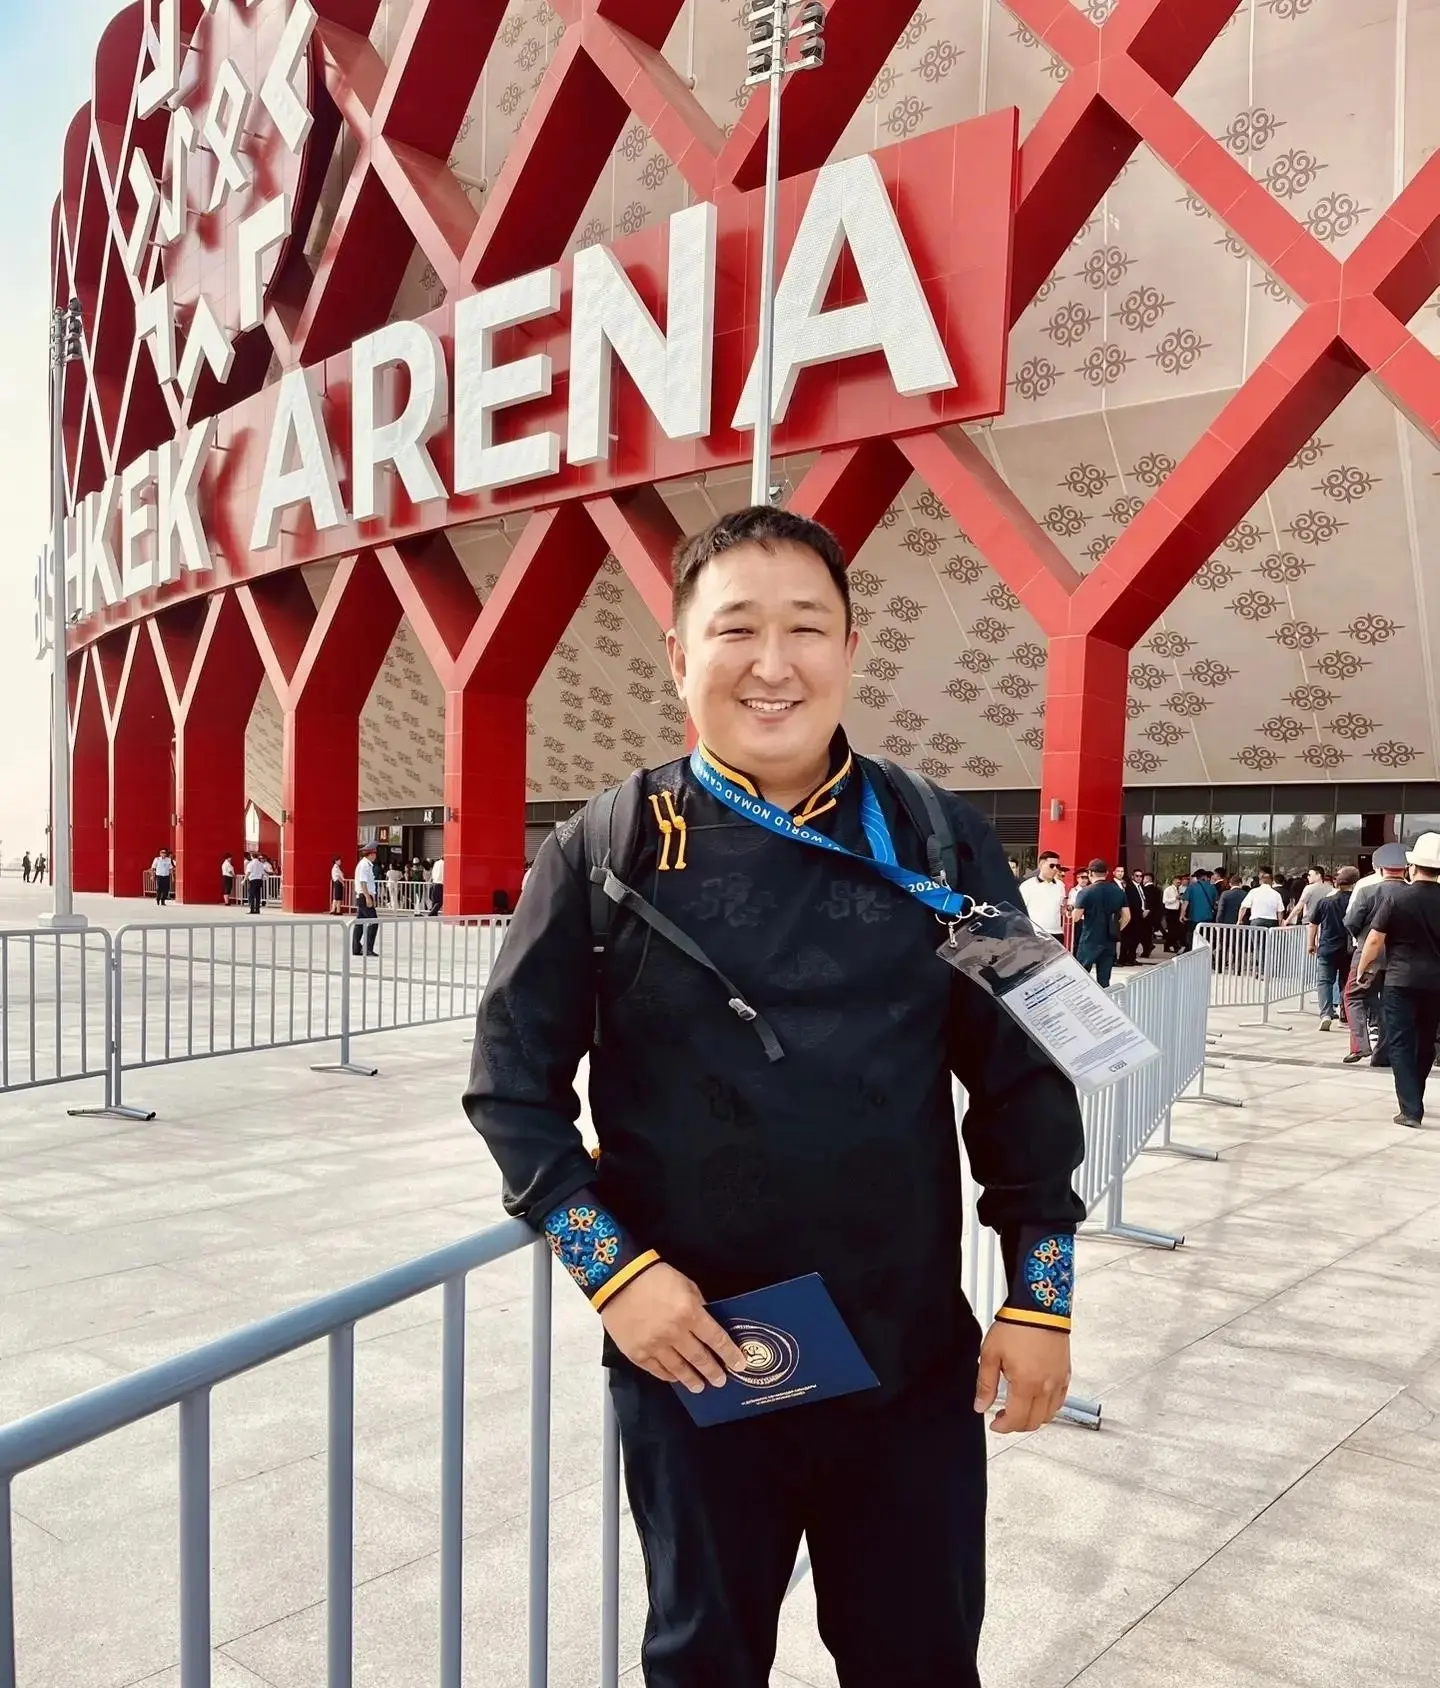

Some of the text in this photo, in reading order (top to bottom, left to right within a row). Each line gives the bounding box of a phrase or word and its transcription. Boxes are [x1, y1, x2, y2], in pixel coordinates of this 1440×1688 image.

[249, 153, 958, 552] ARENA
[725, 789, 771, 820] NOMAD
[774, 816, 823, 843] WORLD
[907, 880, 941, 893] 2026
